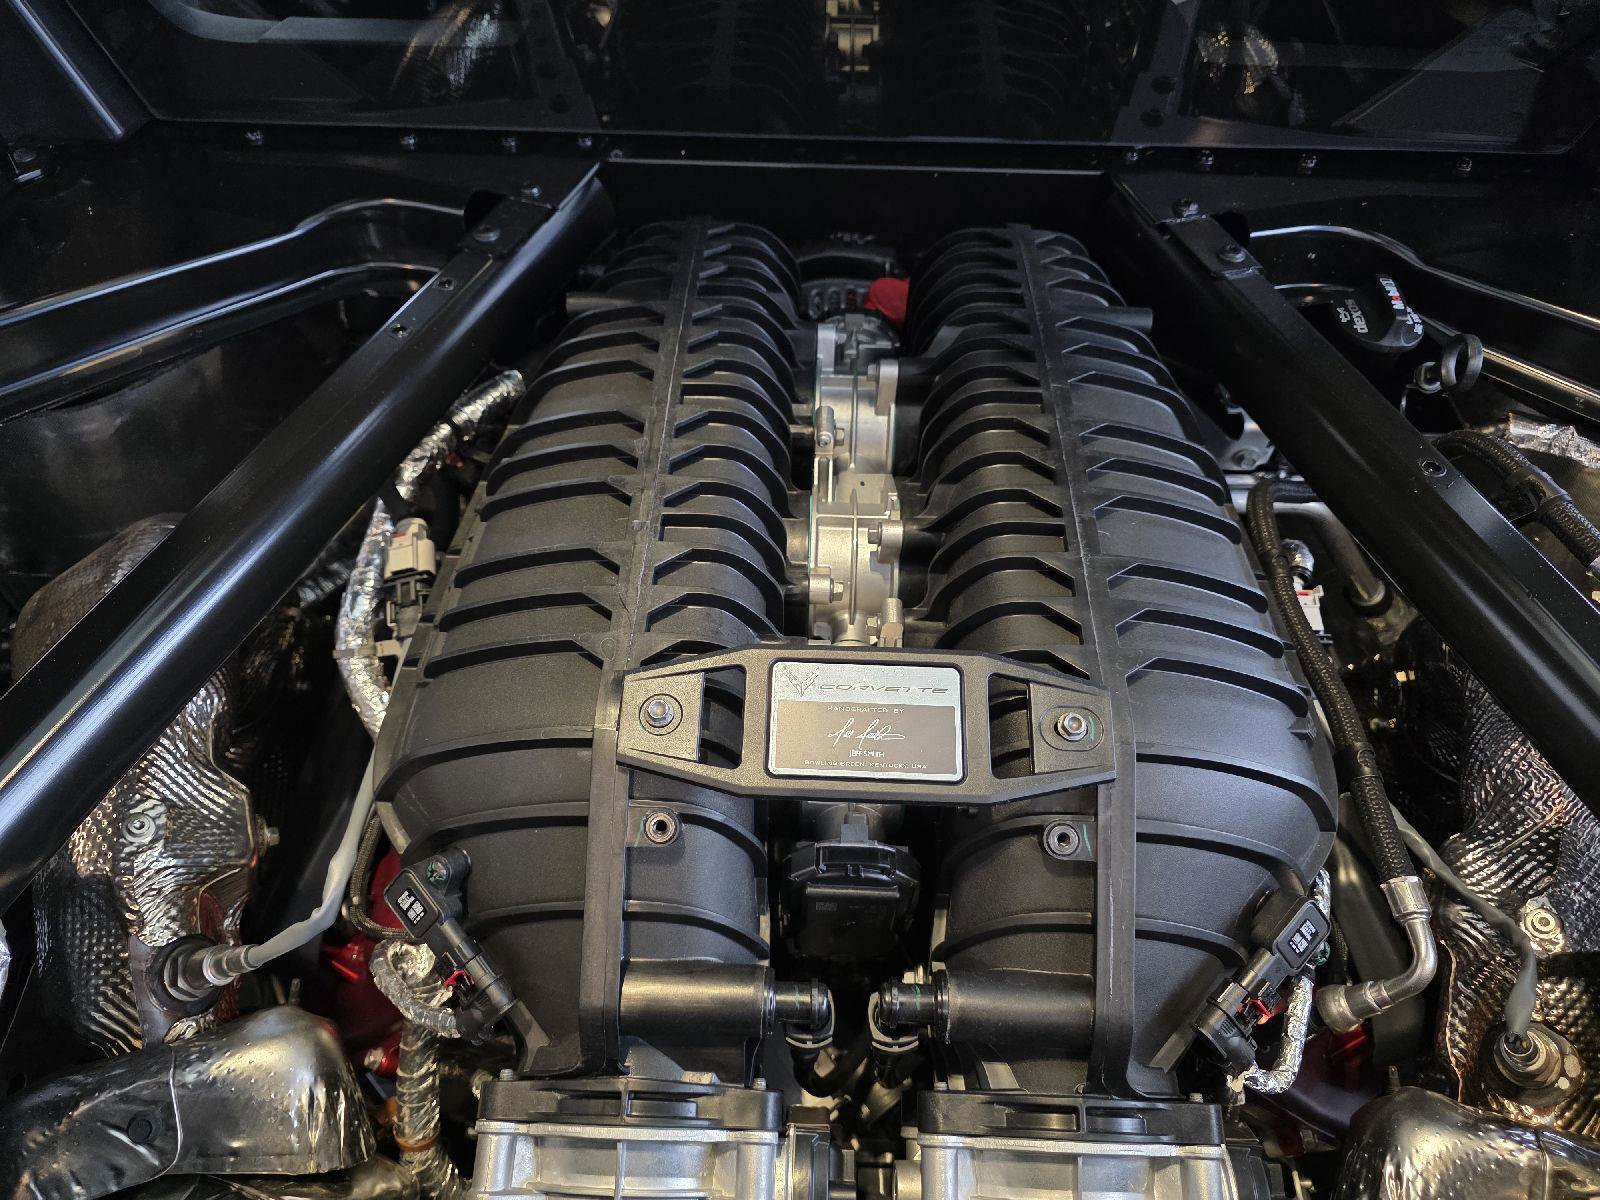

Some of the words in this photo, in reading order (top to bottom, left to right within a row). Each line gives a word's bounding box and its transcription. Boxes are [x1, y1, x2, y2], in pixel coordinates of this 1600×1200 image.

[1345, 299, 1368, 333] dexos
[819, 684, 949, 694] CORVETTE
[827, 705, 889, 713] HANDCRAFTED
[848, 749, 863, 757] JEFF
[863, 750, 885, 758] SMITH
